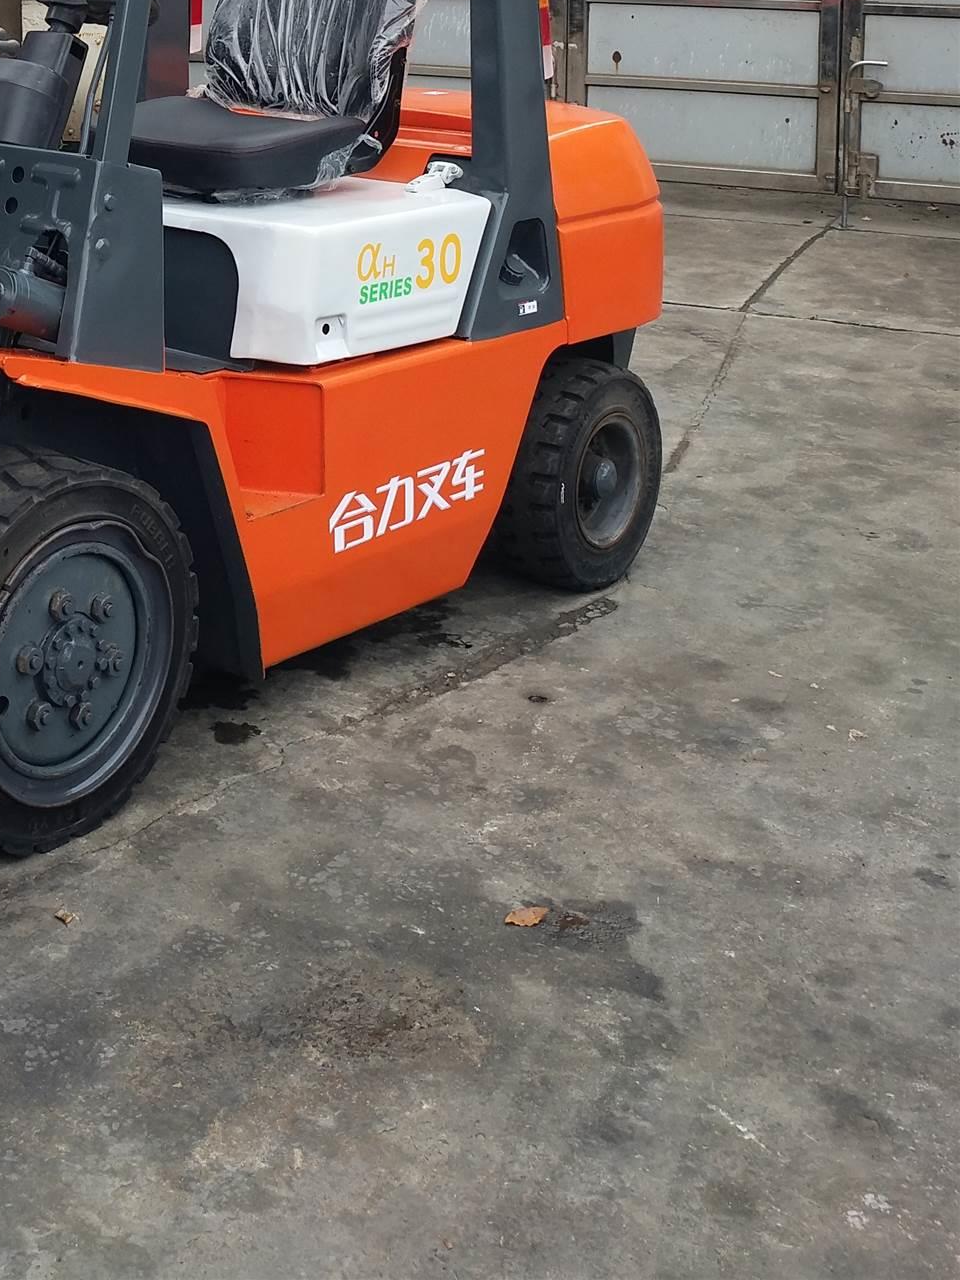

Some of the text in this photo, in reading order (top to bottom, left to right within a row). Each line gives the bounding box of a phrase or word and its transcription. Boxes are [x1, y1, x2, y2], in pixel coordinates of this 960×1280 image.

[415, 233, 462, 289] 30
[359, 276, 413, 305] SERIES
[328, 448, 486, 554] 合力叉车
